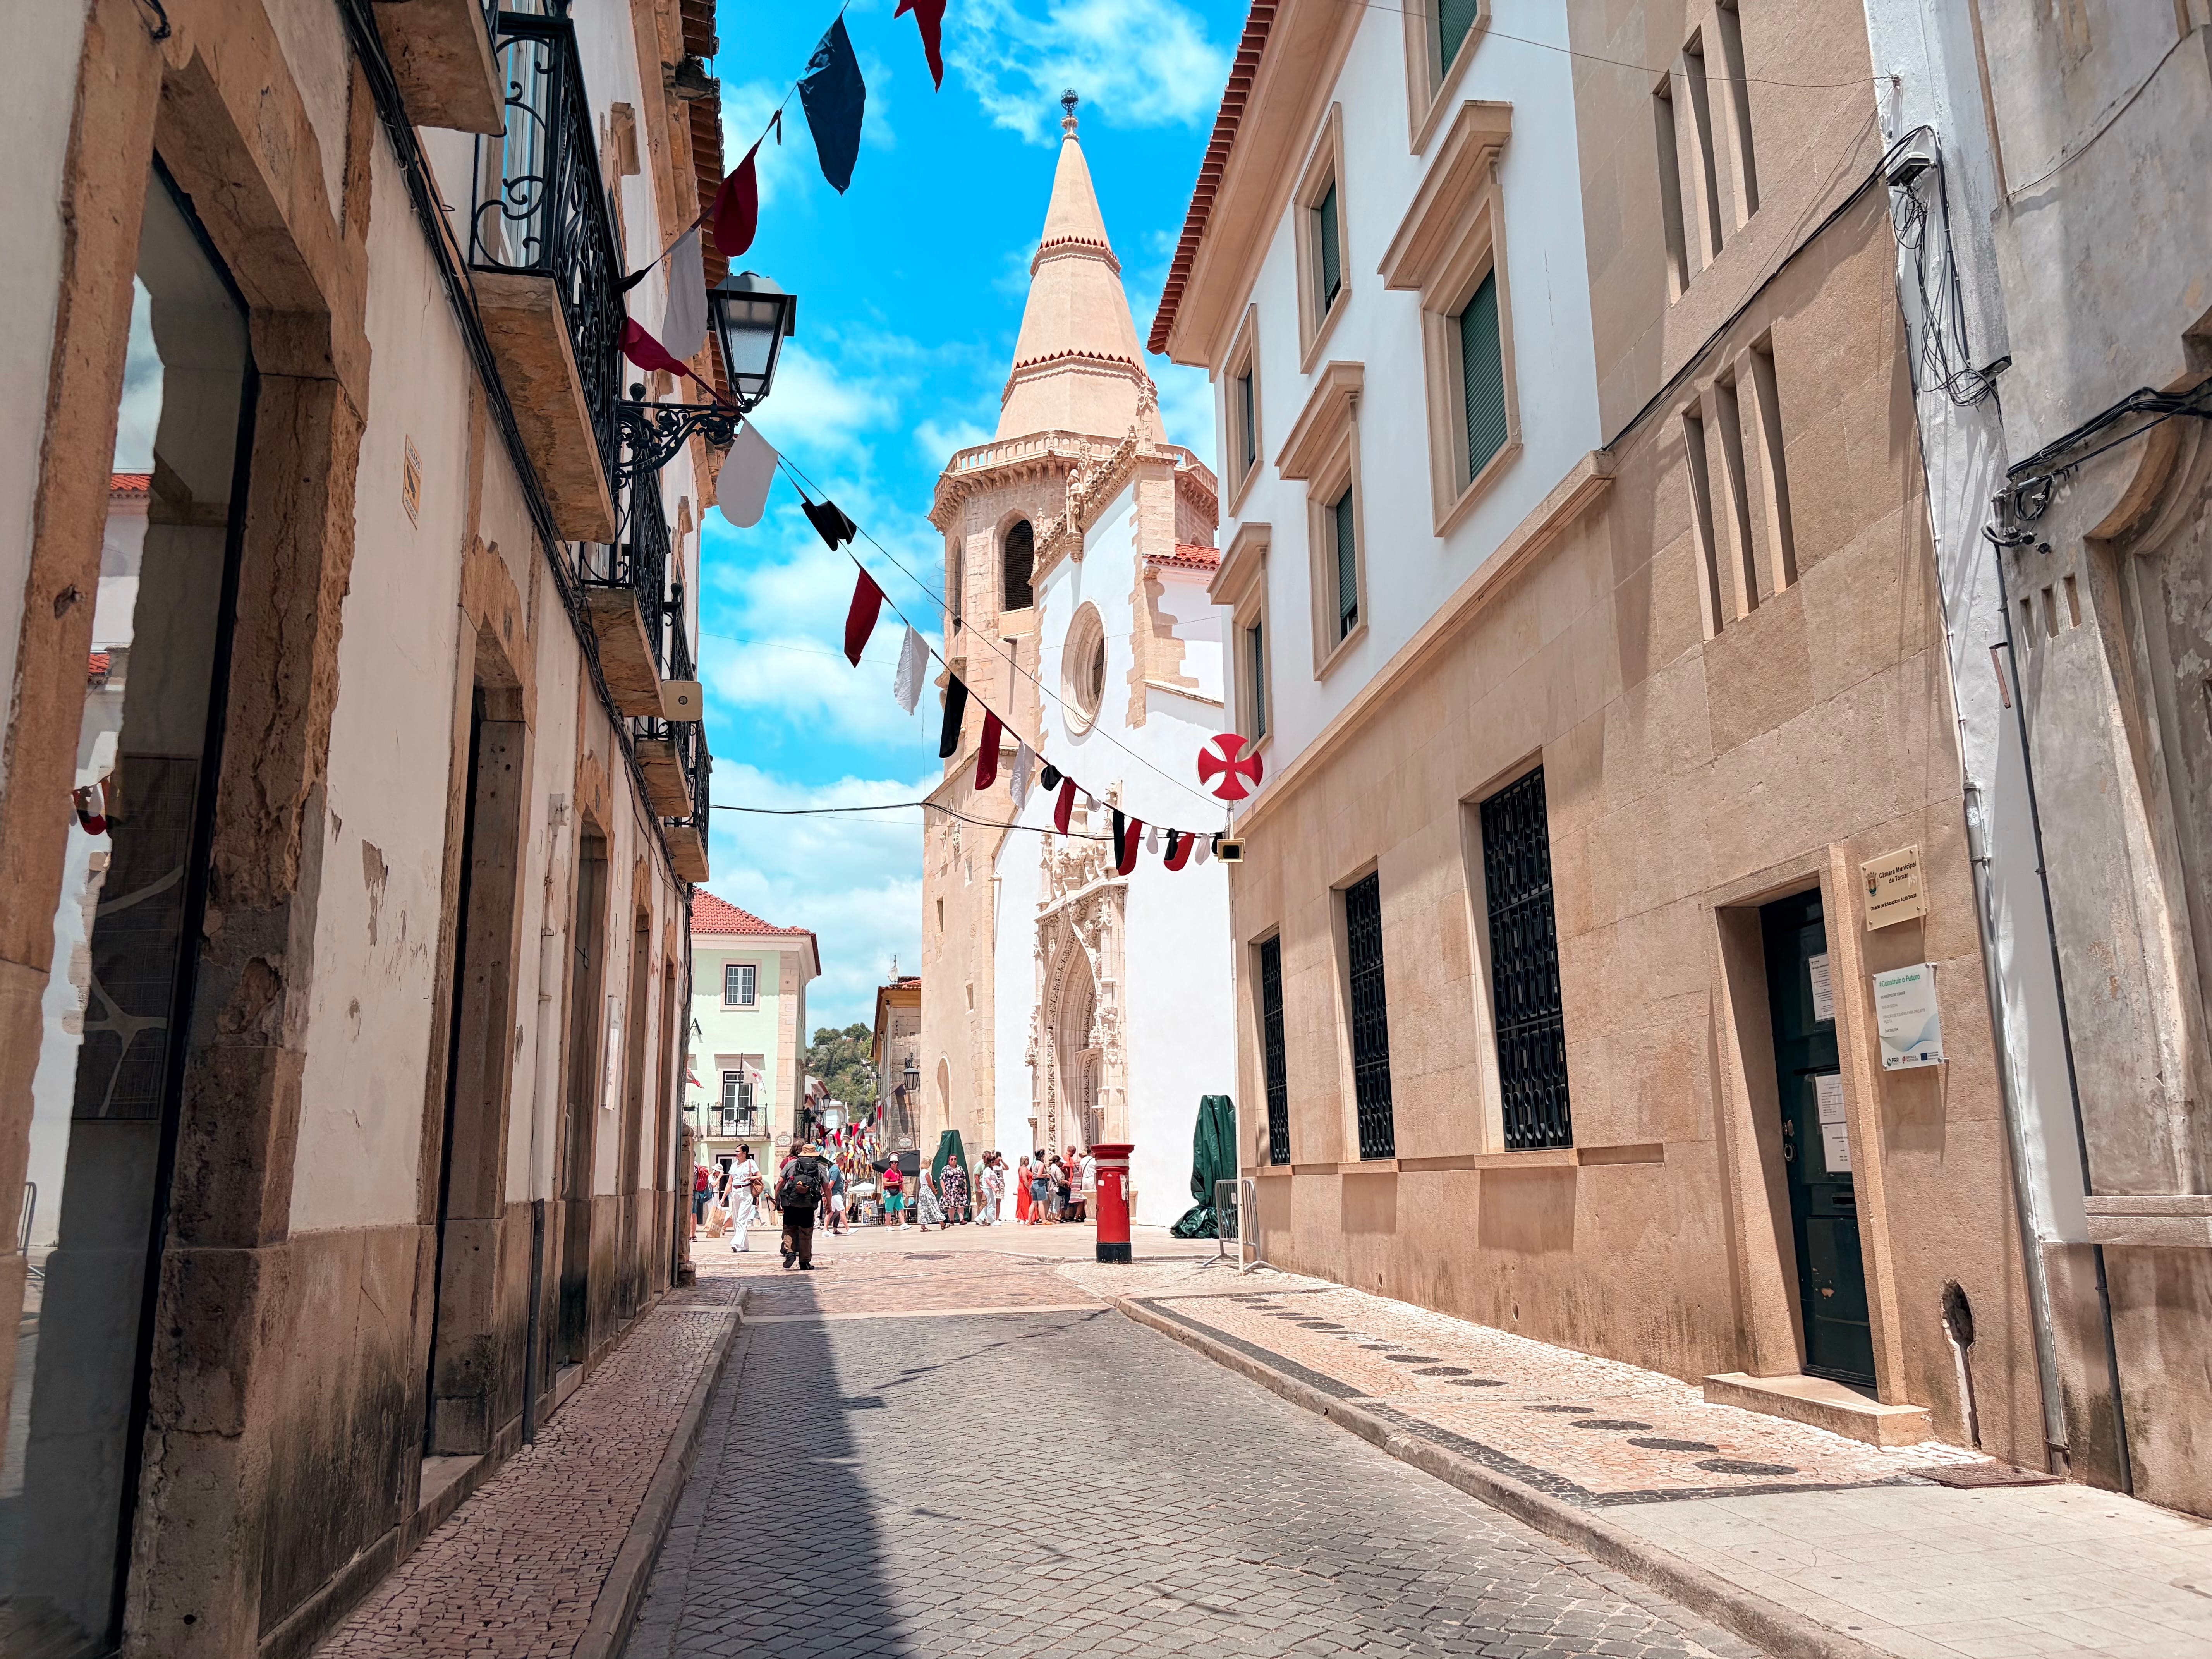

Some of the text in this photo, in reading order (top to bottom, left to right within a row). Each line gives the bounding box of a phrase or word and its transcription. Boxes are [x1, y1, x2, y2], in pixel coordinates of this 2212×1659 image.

[1879, 861, 1917, 879] Câmara Municipal
[1895, 873, 1908, 881] Tomar
[1879, 977, 1901, 987] #Construir
[690, 1017, 703, 1035] A
